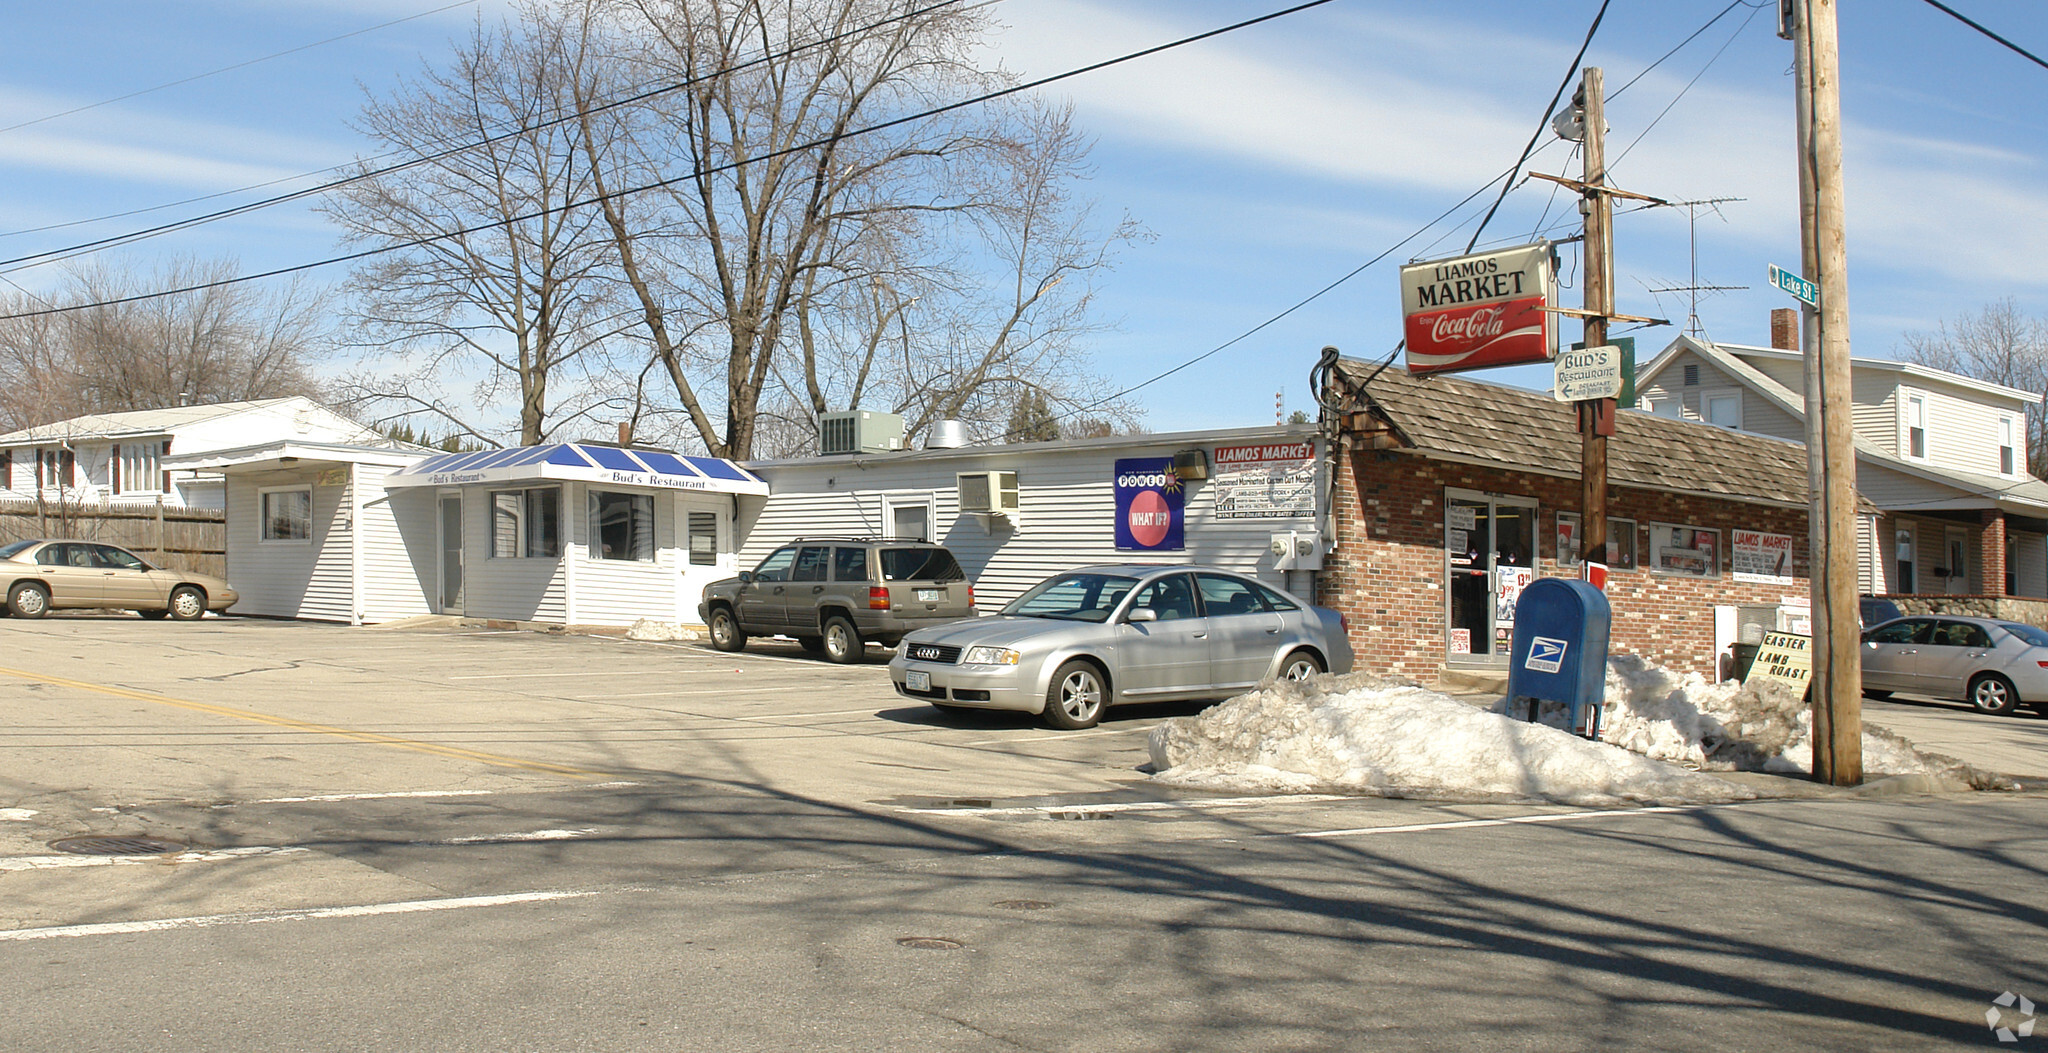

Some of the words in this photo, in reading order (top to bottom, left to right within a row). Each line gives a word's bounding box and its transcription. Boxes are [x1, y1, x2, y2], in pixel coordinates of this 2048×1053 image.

[1436, 258, 1497, 282] LIAMOS
[1417, 270, 1525, 307] MARKET
[1782, 272, 1801, 295] Lake
[1803, 282, 1812, 300] St
[1432, 307, 1506, 343] Coca-Cola
[1217, 448, 1260, 462] LIAMOS
[1262, 446, 1312, 459] MARKET
[433, 474, 448, 483] Bud's
[451, 473, 480, 482] Restaurant
[612, 472, 642, 483] Bud's
[650, 475, 705, 489] Restaurant
[1120, 476, 1165, 486] POWER
[1132, 512, 1154, 526] WHAT
[1155, 512, 1167, 526] IF?
[1734, 532, 1759, 546] LIAMOS
[1762, 536, 1791, 550] MARKET
[1764, 635, 1806, 650] EASTER
[1757, 651, 1790, 665] LAMB
[1769, 665, 1808, 680] ROAST
